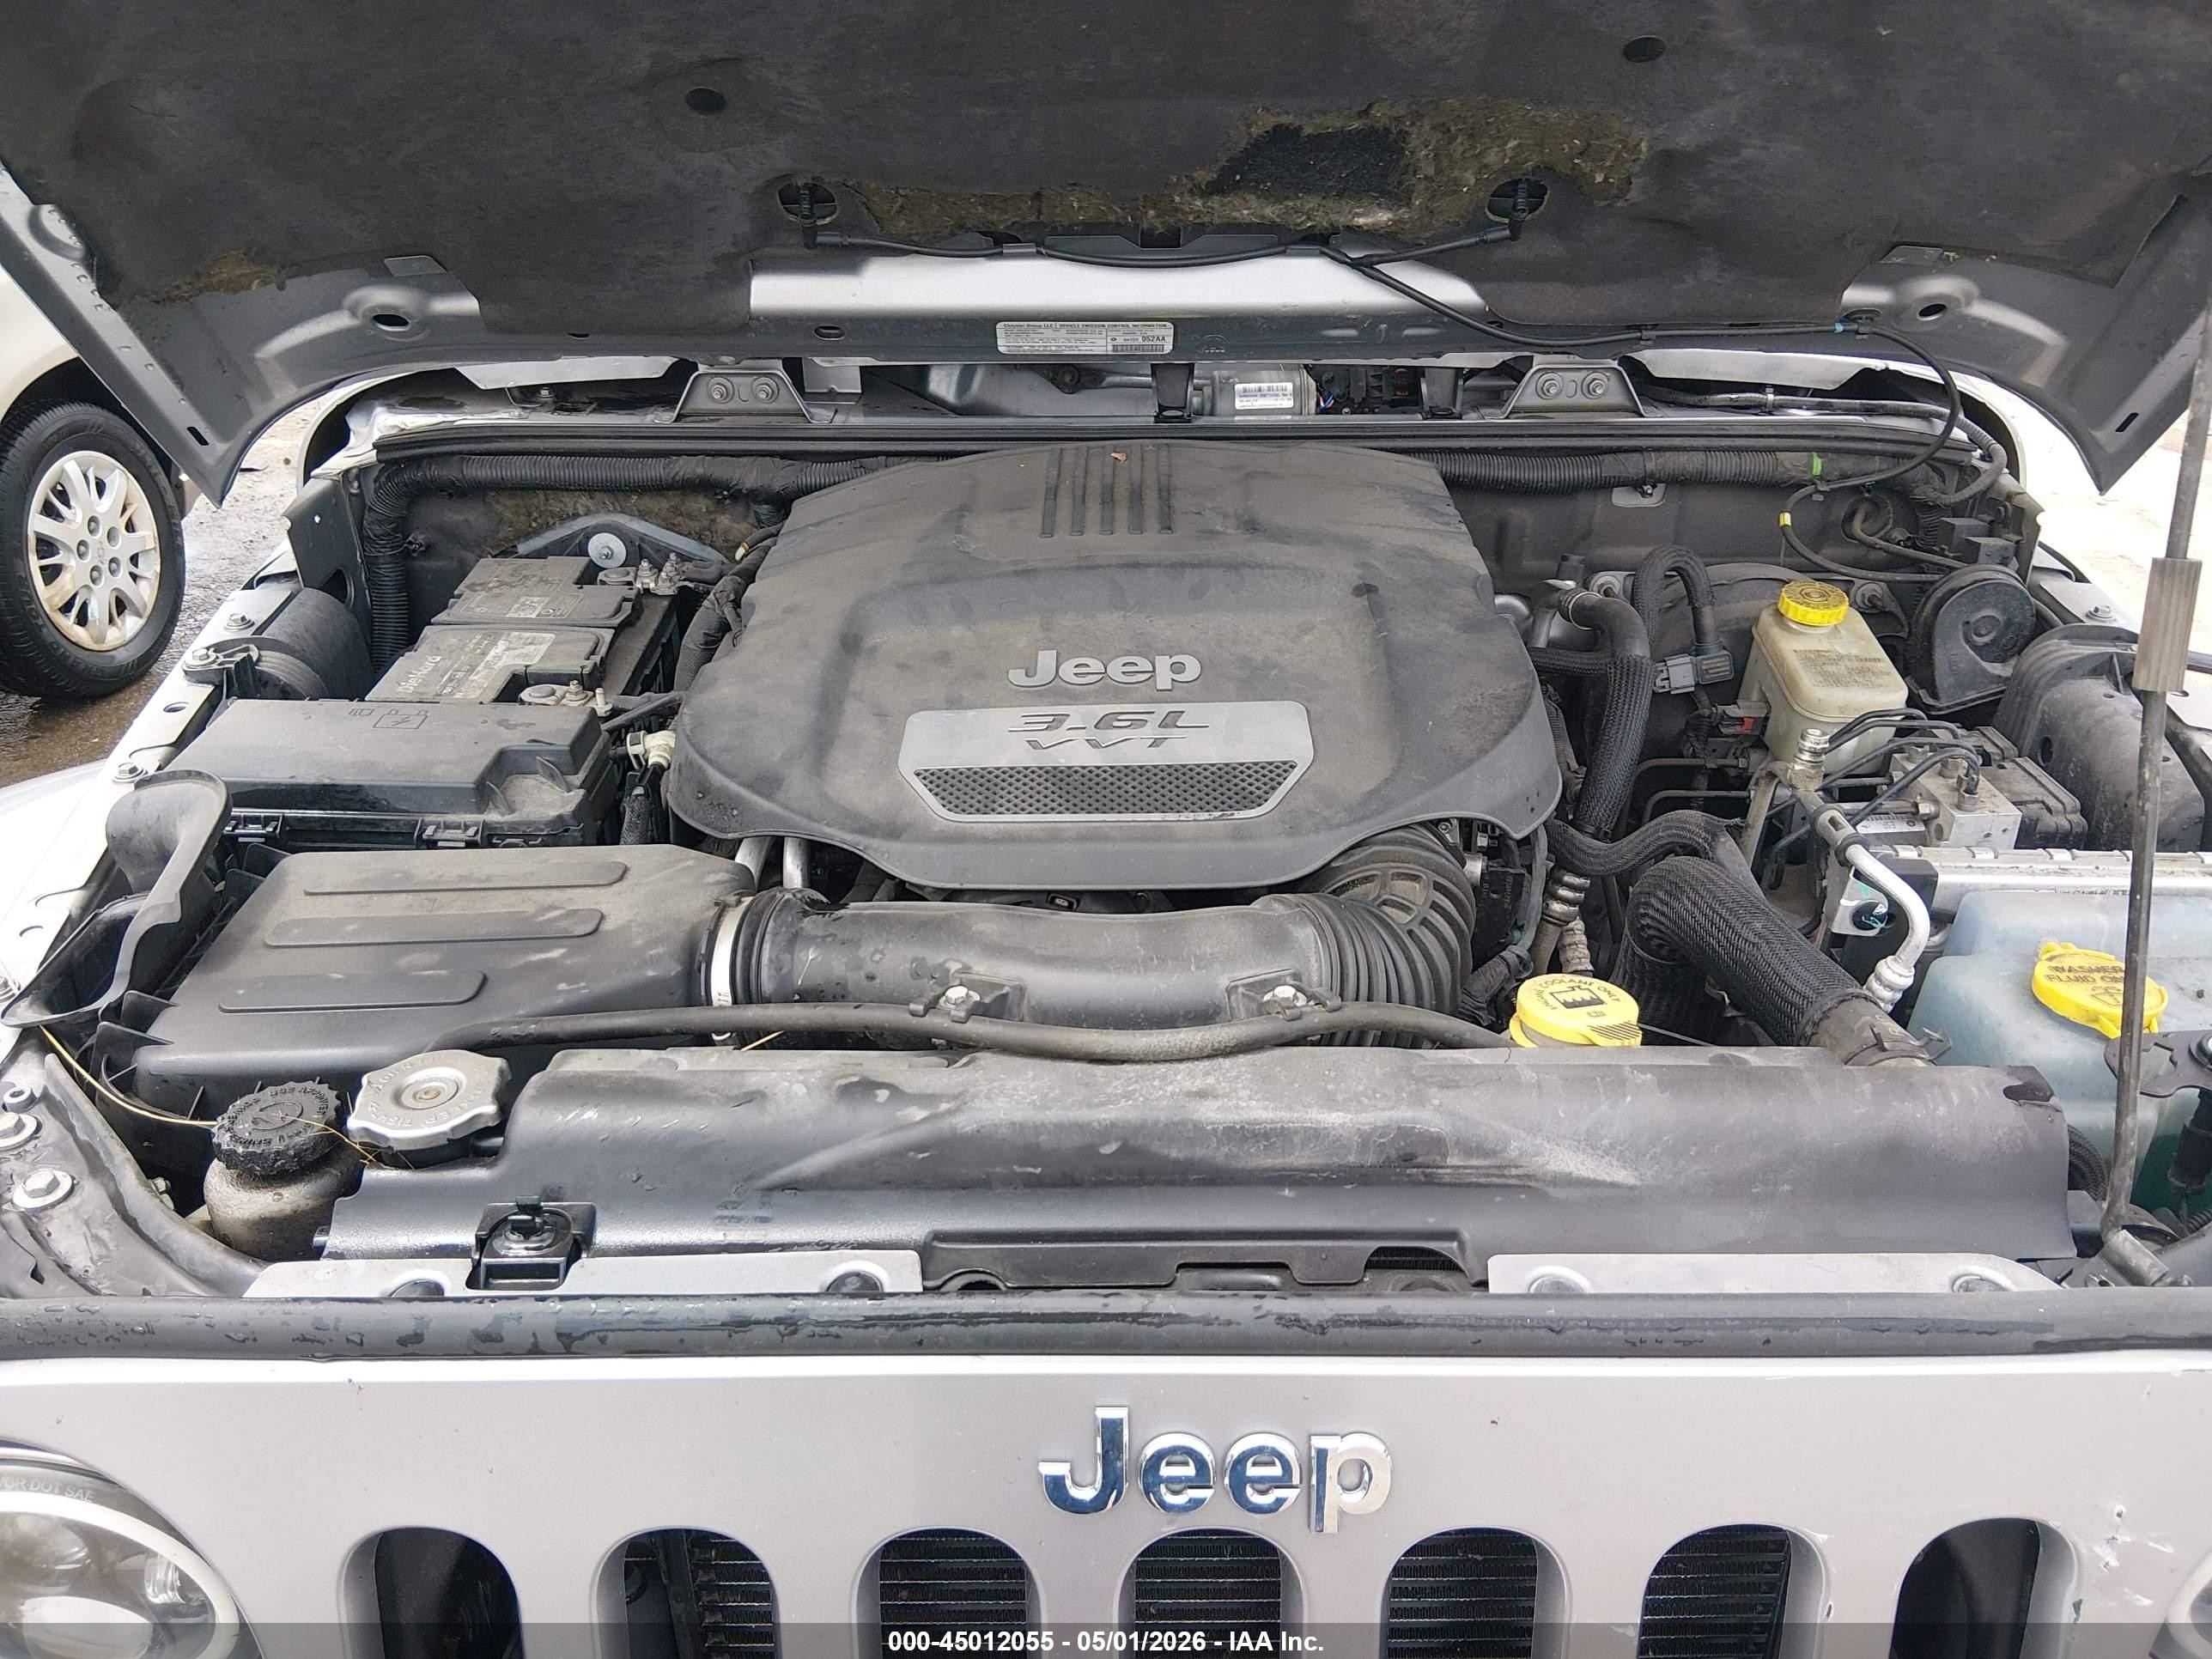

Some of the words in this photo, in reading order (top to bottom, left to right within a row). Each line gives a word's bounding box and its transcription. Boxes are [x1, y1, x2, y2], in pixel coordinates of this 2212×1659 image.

[1008, 650, 1202, 692] Jeep
[1008, 710, 1210, 732] 3.6L
[2045, 974, 2097, 983] FLUID
[2100, 975, 2124, 983] ON
[2046, 965, 2124, 975] WASHER
[1540, 978, 1595, 989] COOLANT
[1597, 985, 1622, 1002] ONLY
[1038, 1406, 1393, 1534] Jeep
[28, 1479, 63, 1495] DOT
[64, 1484, 96, 1504] SAE
